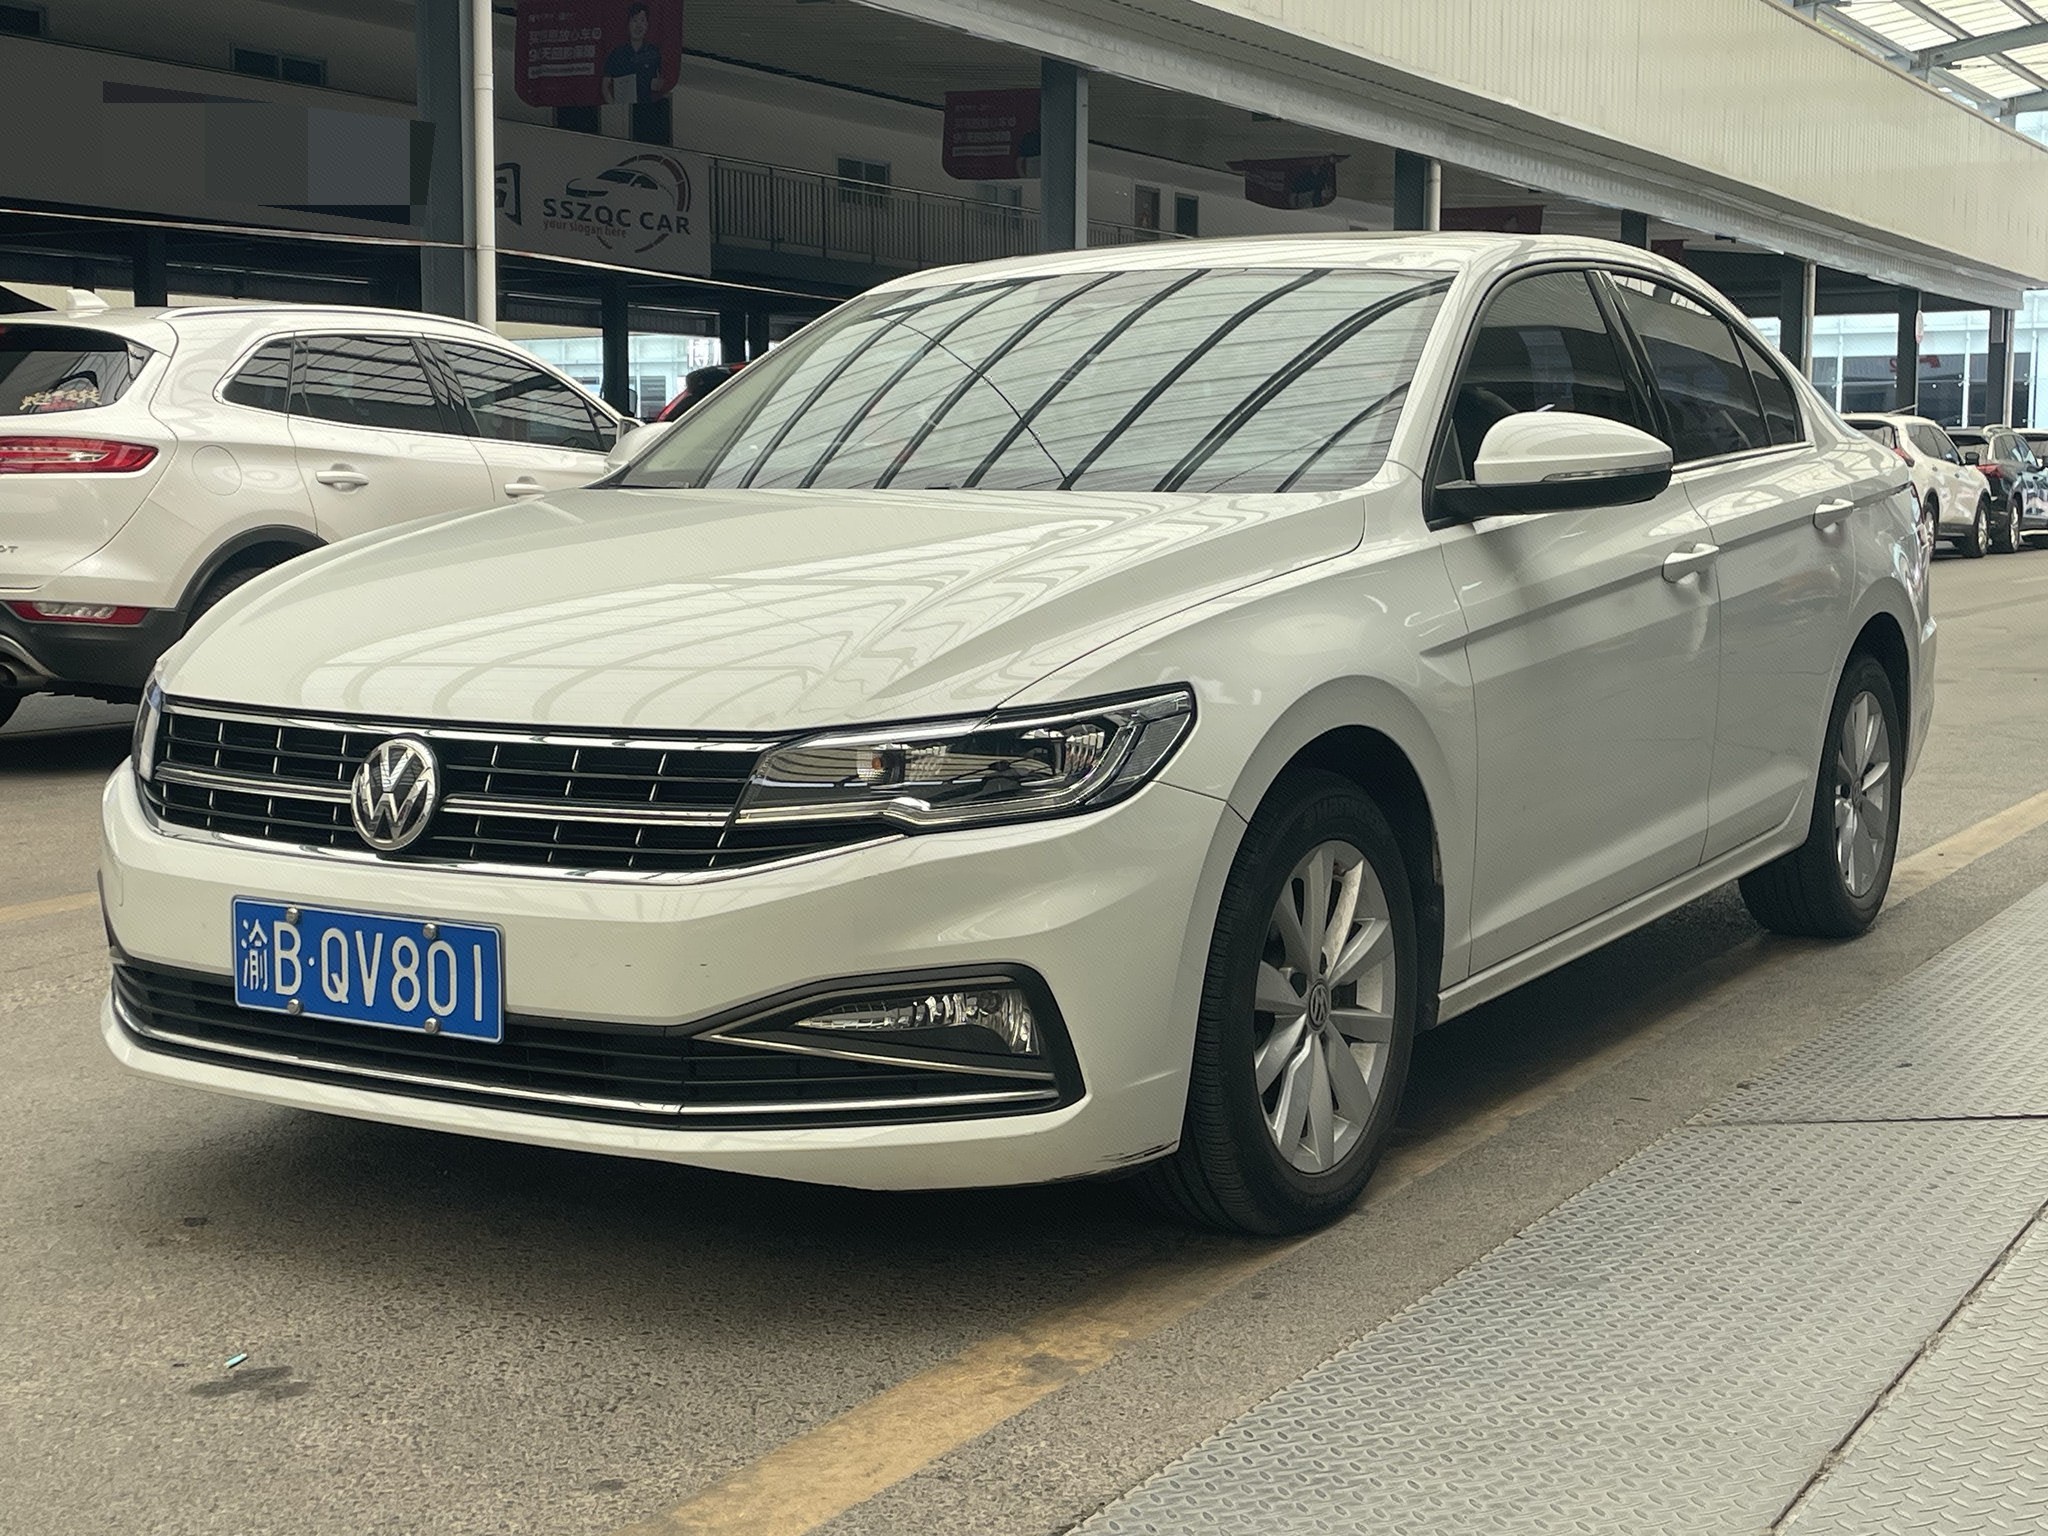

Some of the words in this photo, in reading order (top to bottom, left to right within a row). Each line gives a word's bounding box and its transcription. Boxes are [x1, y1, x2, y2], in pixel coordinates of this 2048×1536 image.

[543, 198, 632, 228] SSZQC
[639, 211, 691, 235] CAR
[543, 219, 567, 231] your
[570, 221, 601, 237] slogan
[603, 225, 627, 239] here
